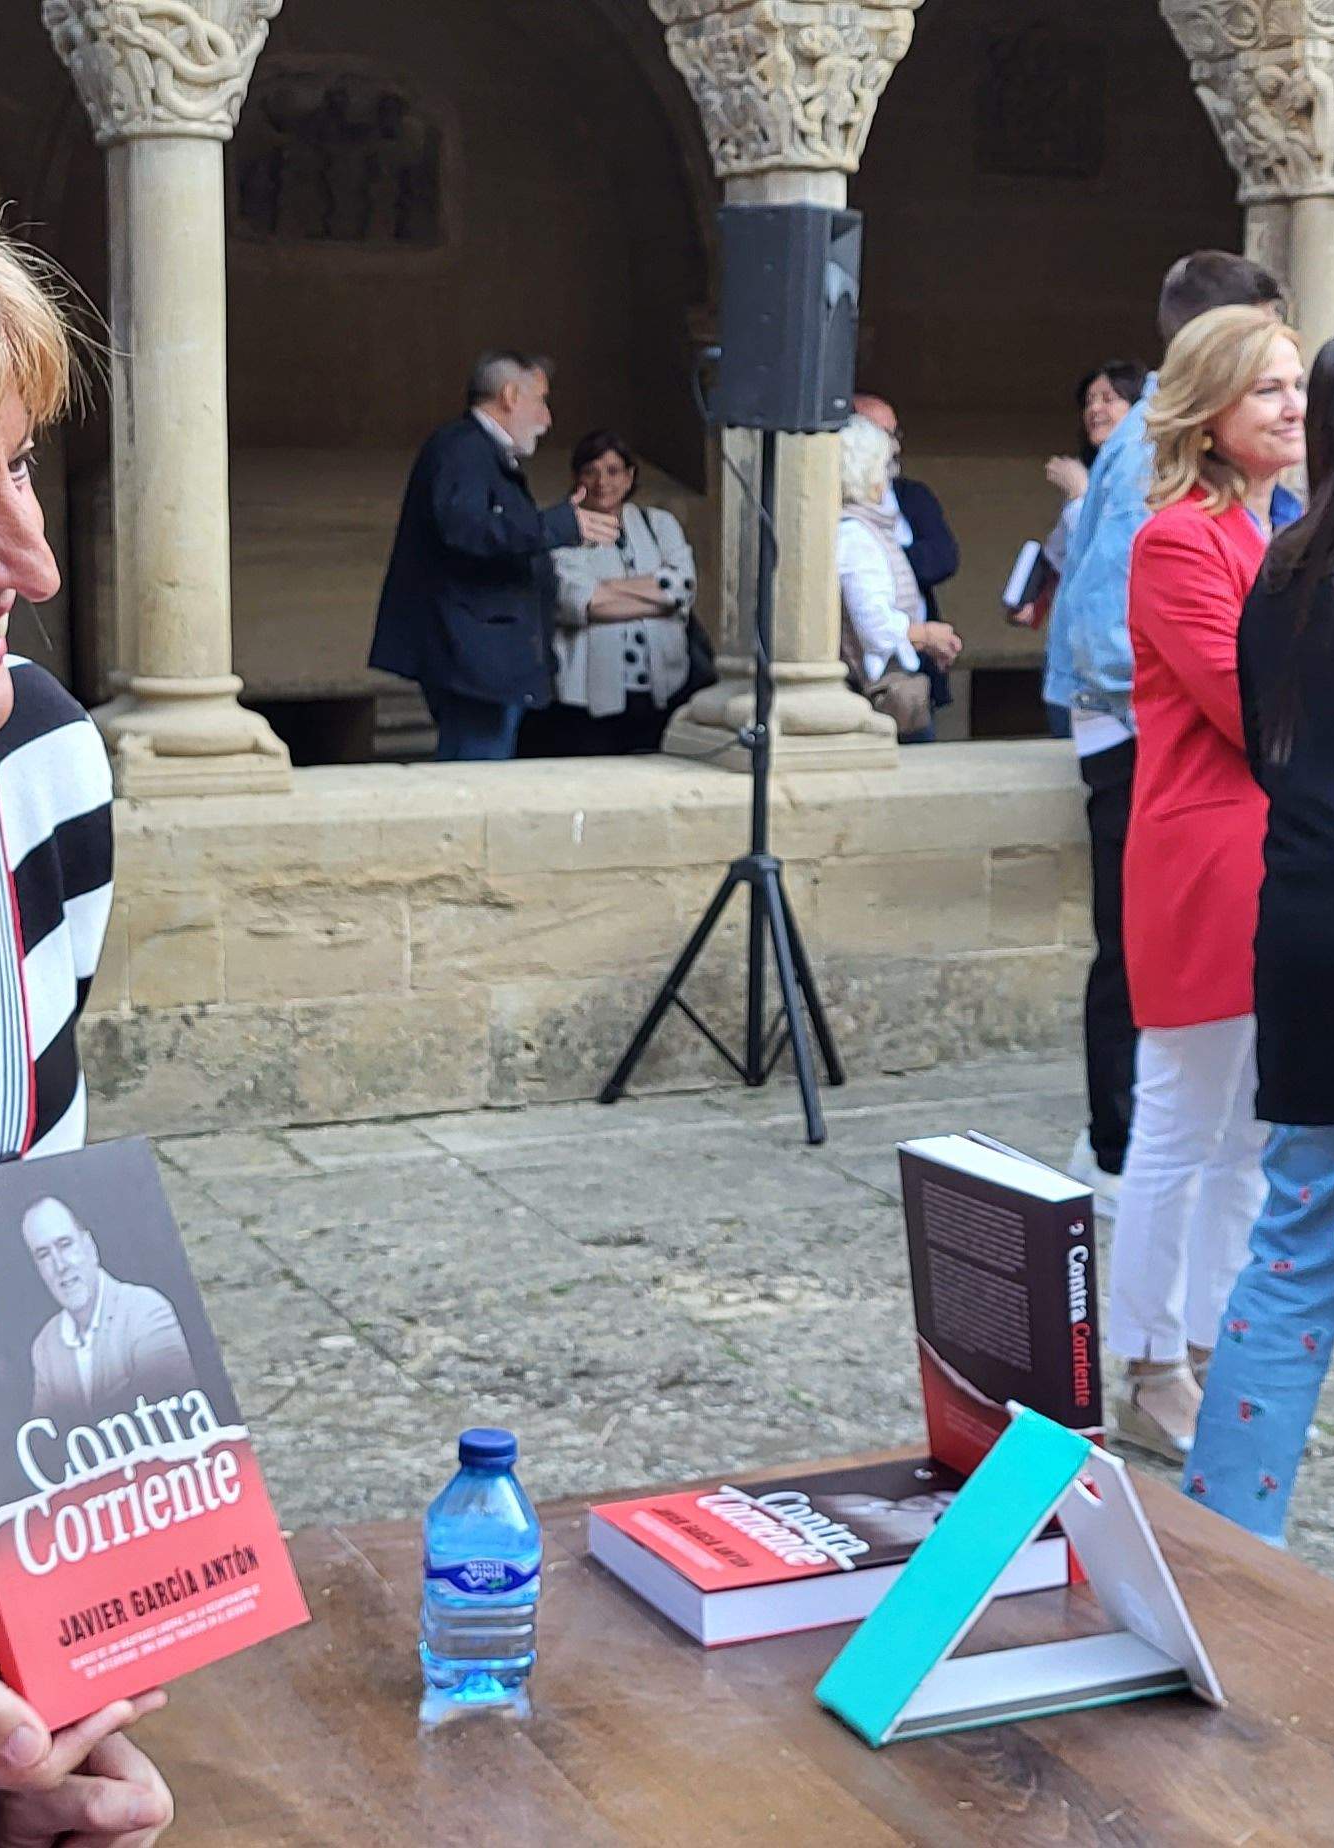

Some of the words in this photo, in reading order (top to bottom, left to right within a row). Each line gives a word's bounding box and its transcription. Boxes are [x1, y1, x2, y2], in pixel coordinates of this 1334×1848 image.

[1069, 1245, 1090, 1323] Contra
[1072, 1322, 1092, 1407] Corriente
[17, 1389, 222, 1491] Contra
[15, 1449, 241, 1575] Corriente
[753, 1490, 870, 1560] Contra
[58, 1598, 129, 1647] JAVIER
[129, 1567, 200, 1617] GARCÍA
[201, 1545, 260, 1589] ANTÓN
